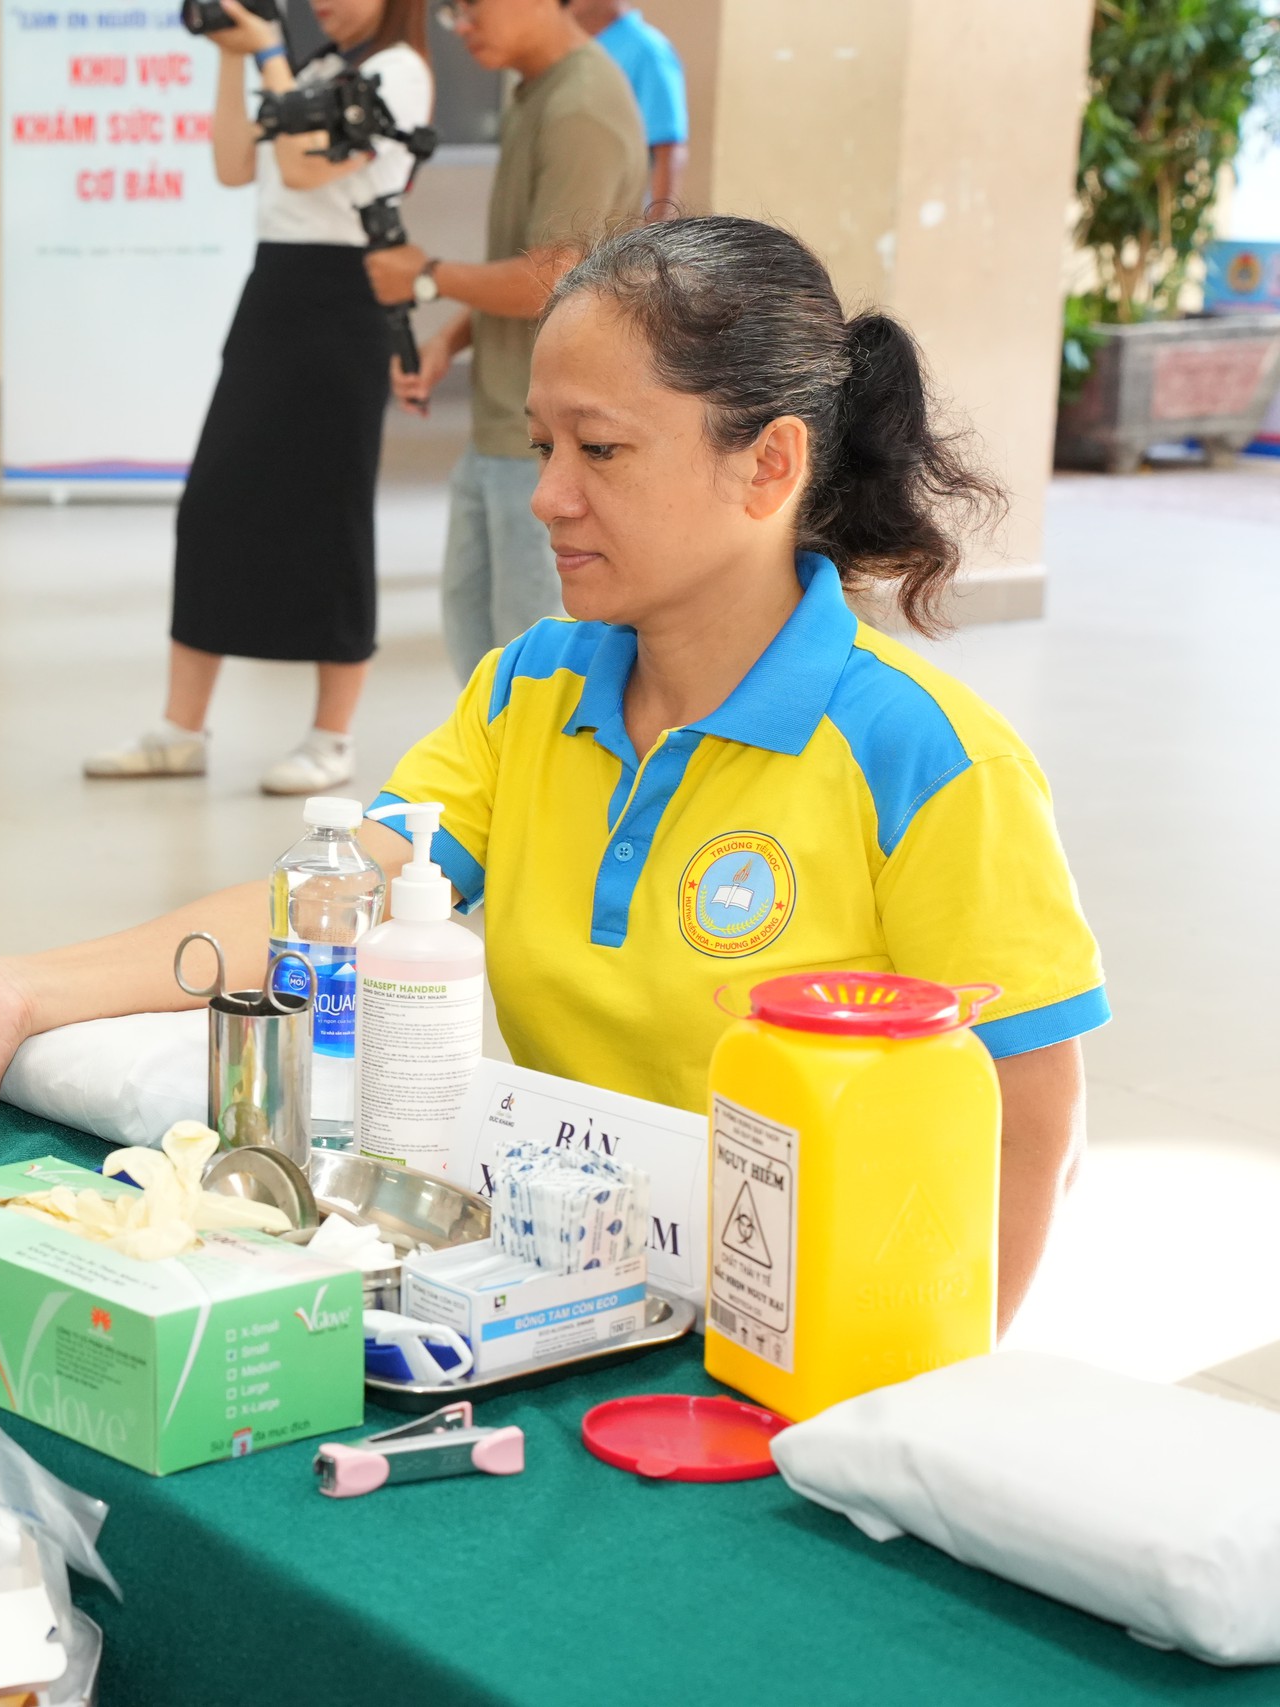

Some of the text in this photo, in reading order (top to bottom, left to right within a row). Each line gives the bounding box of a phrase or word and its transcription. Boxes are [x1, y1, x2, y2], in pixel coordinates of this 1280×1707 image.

[69, 53, 192, 94] KHU VỰC
[13, 107, 214, 145] KHÁM SỨC KH
[77, 159, 184, 201] CƠ BẢN
[710, 841, 753, 859] TRƯỜNG
[767, 852, 781, 872] HỌC
[750, 935, 761, 945] AN
[363, 978, 448, 994] ALFASEPT HANDRUB
[718, 1143, 785, 1192] NGUY HIỂM
[515, 1313, 547, 1331] BÔNG
[596, 1294, 619, 1310] ECO
[240, 1319, 280, 1338] X-Small
[241, 1342, 270, 1358] Small
[241, 1360, 282, 1378] Medium
[241, 1381, 270, 1397] Large
[241, 1398, 281, 1415] X-Large
